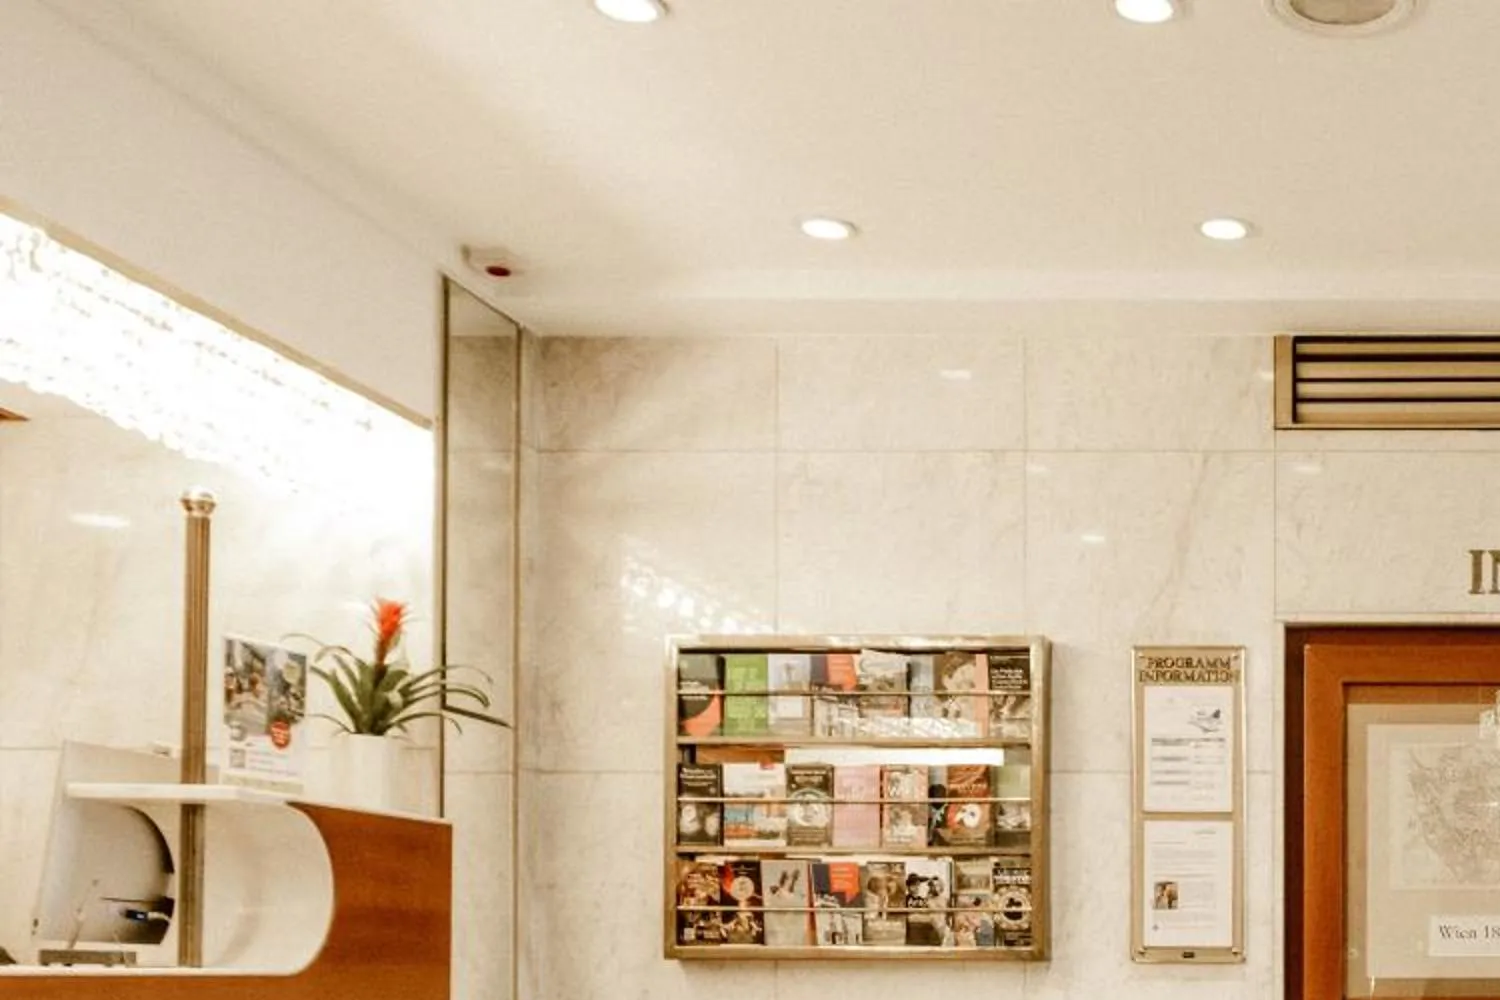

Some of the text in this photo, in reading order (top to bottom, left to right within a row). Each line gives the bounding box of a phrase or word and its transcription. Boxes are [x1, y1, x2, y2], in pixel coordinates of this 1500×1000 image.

[1147, 656, 1231, 669] PROGRAMM
[1139, 669, 1241, 682] INFORMATION
[1438, 924, 1477, 939] Wien
